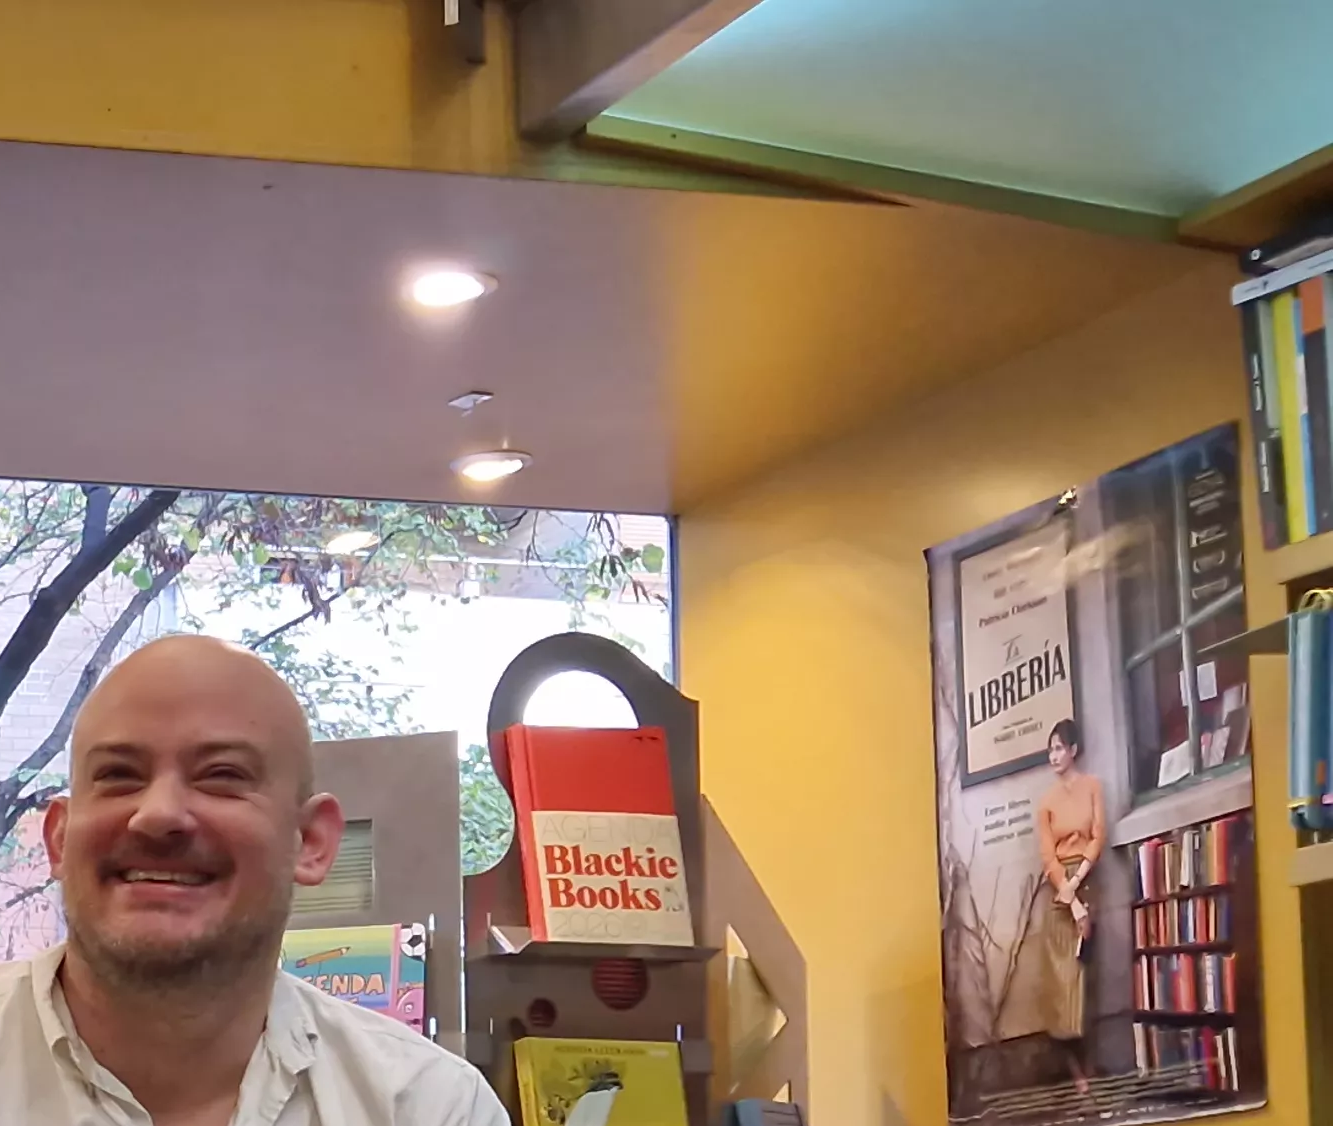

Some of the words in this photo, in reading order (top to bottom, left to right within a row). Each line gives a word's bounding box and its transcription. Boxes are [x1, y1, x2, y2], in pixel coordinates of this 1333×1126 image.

[967, 639, 1066, 729] LIBRERÍA
[543, 844, 678, 879] Blackie
[546, 878, 663, 911] Books
